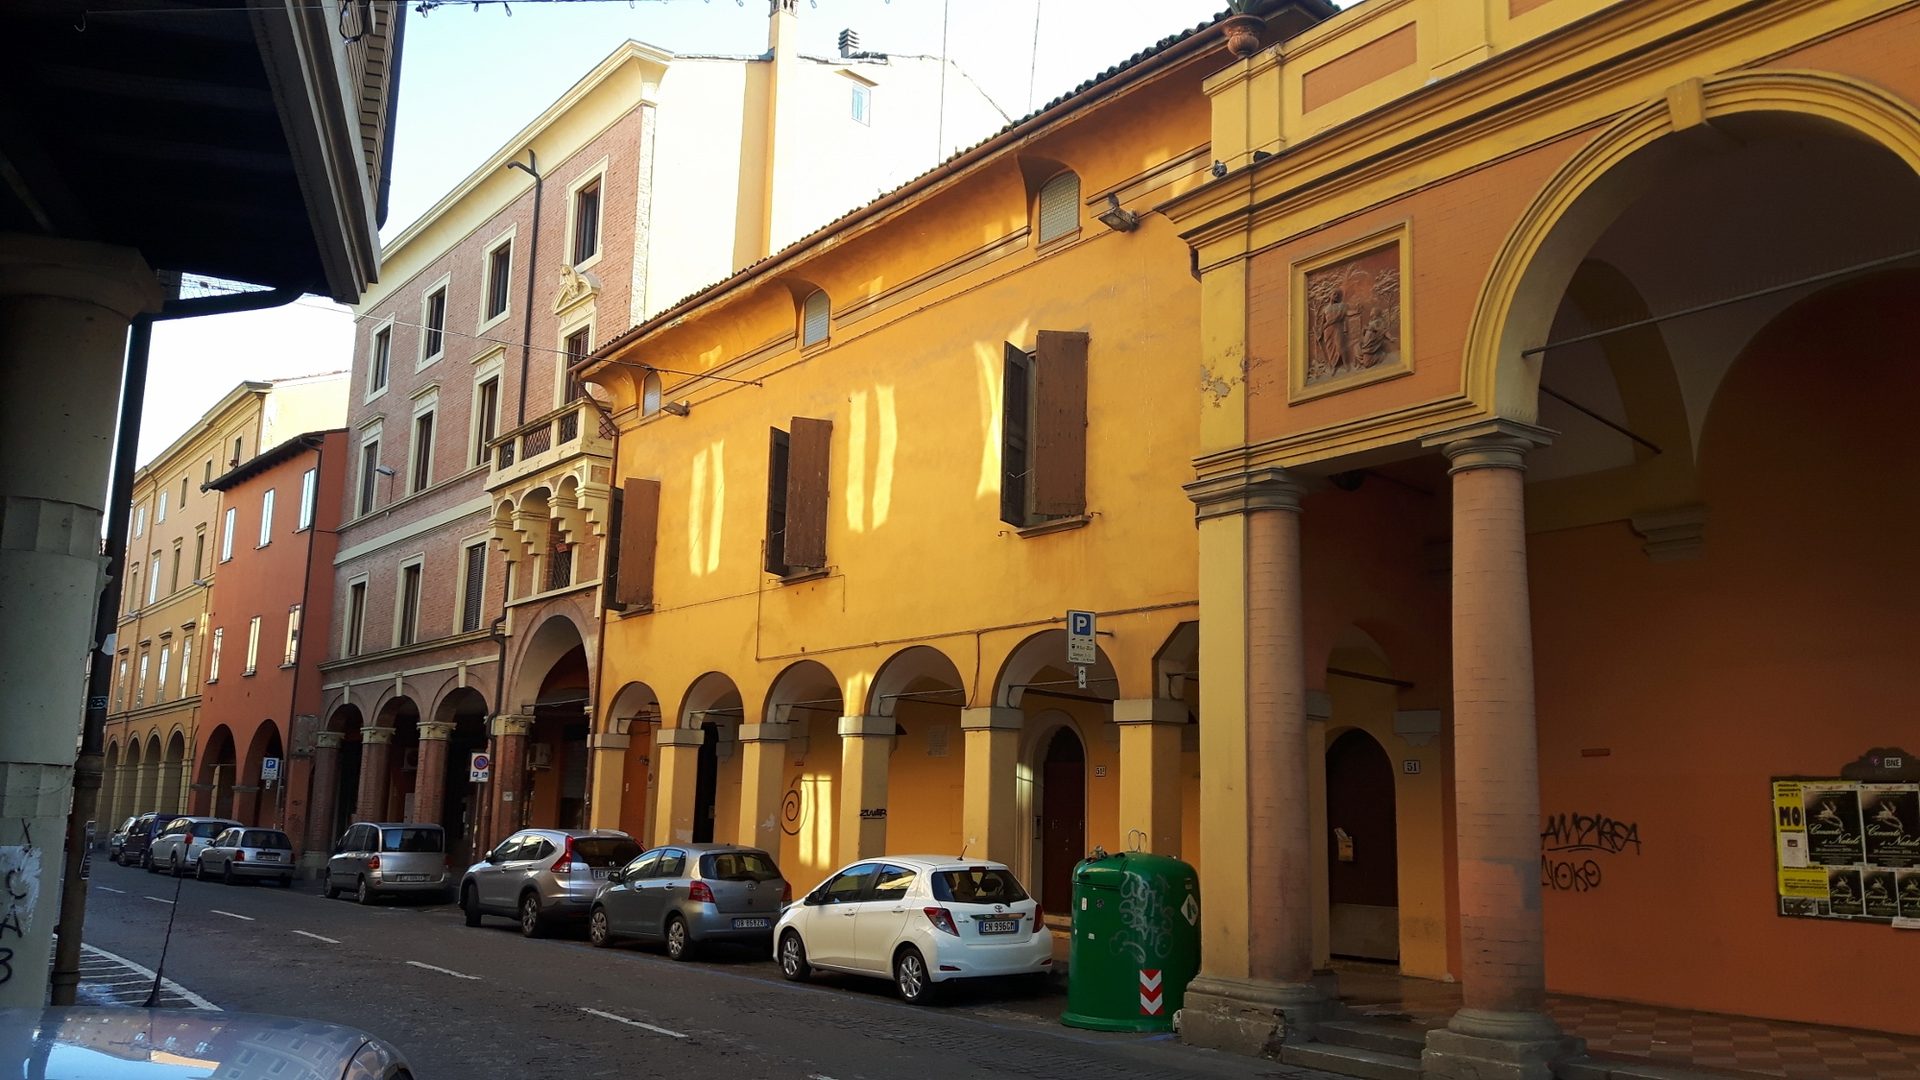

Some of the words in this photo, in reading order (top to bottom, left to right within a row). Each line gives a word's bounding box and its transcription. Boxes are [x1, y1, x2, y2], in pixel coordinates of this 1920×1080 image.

[1076, 616, 1088, 633] P
[267, 760, 274, 768] P
[1406, 762, 1417, 772] 51
[1779, 806, 1804, 827] MO
[984, 922, 993, 932] EN
